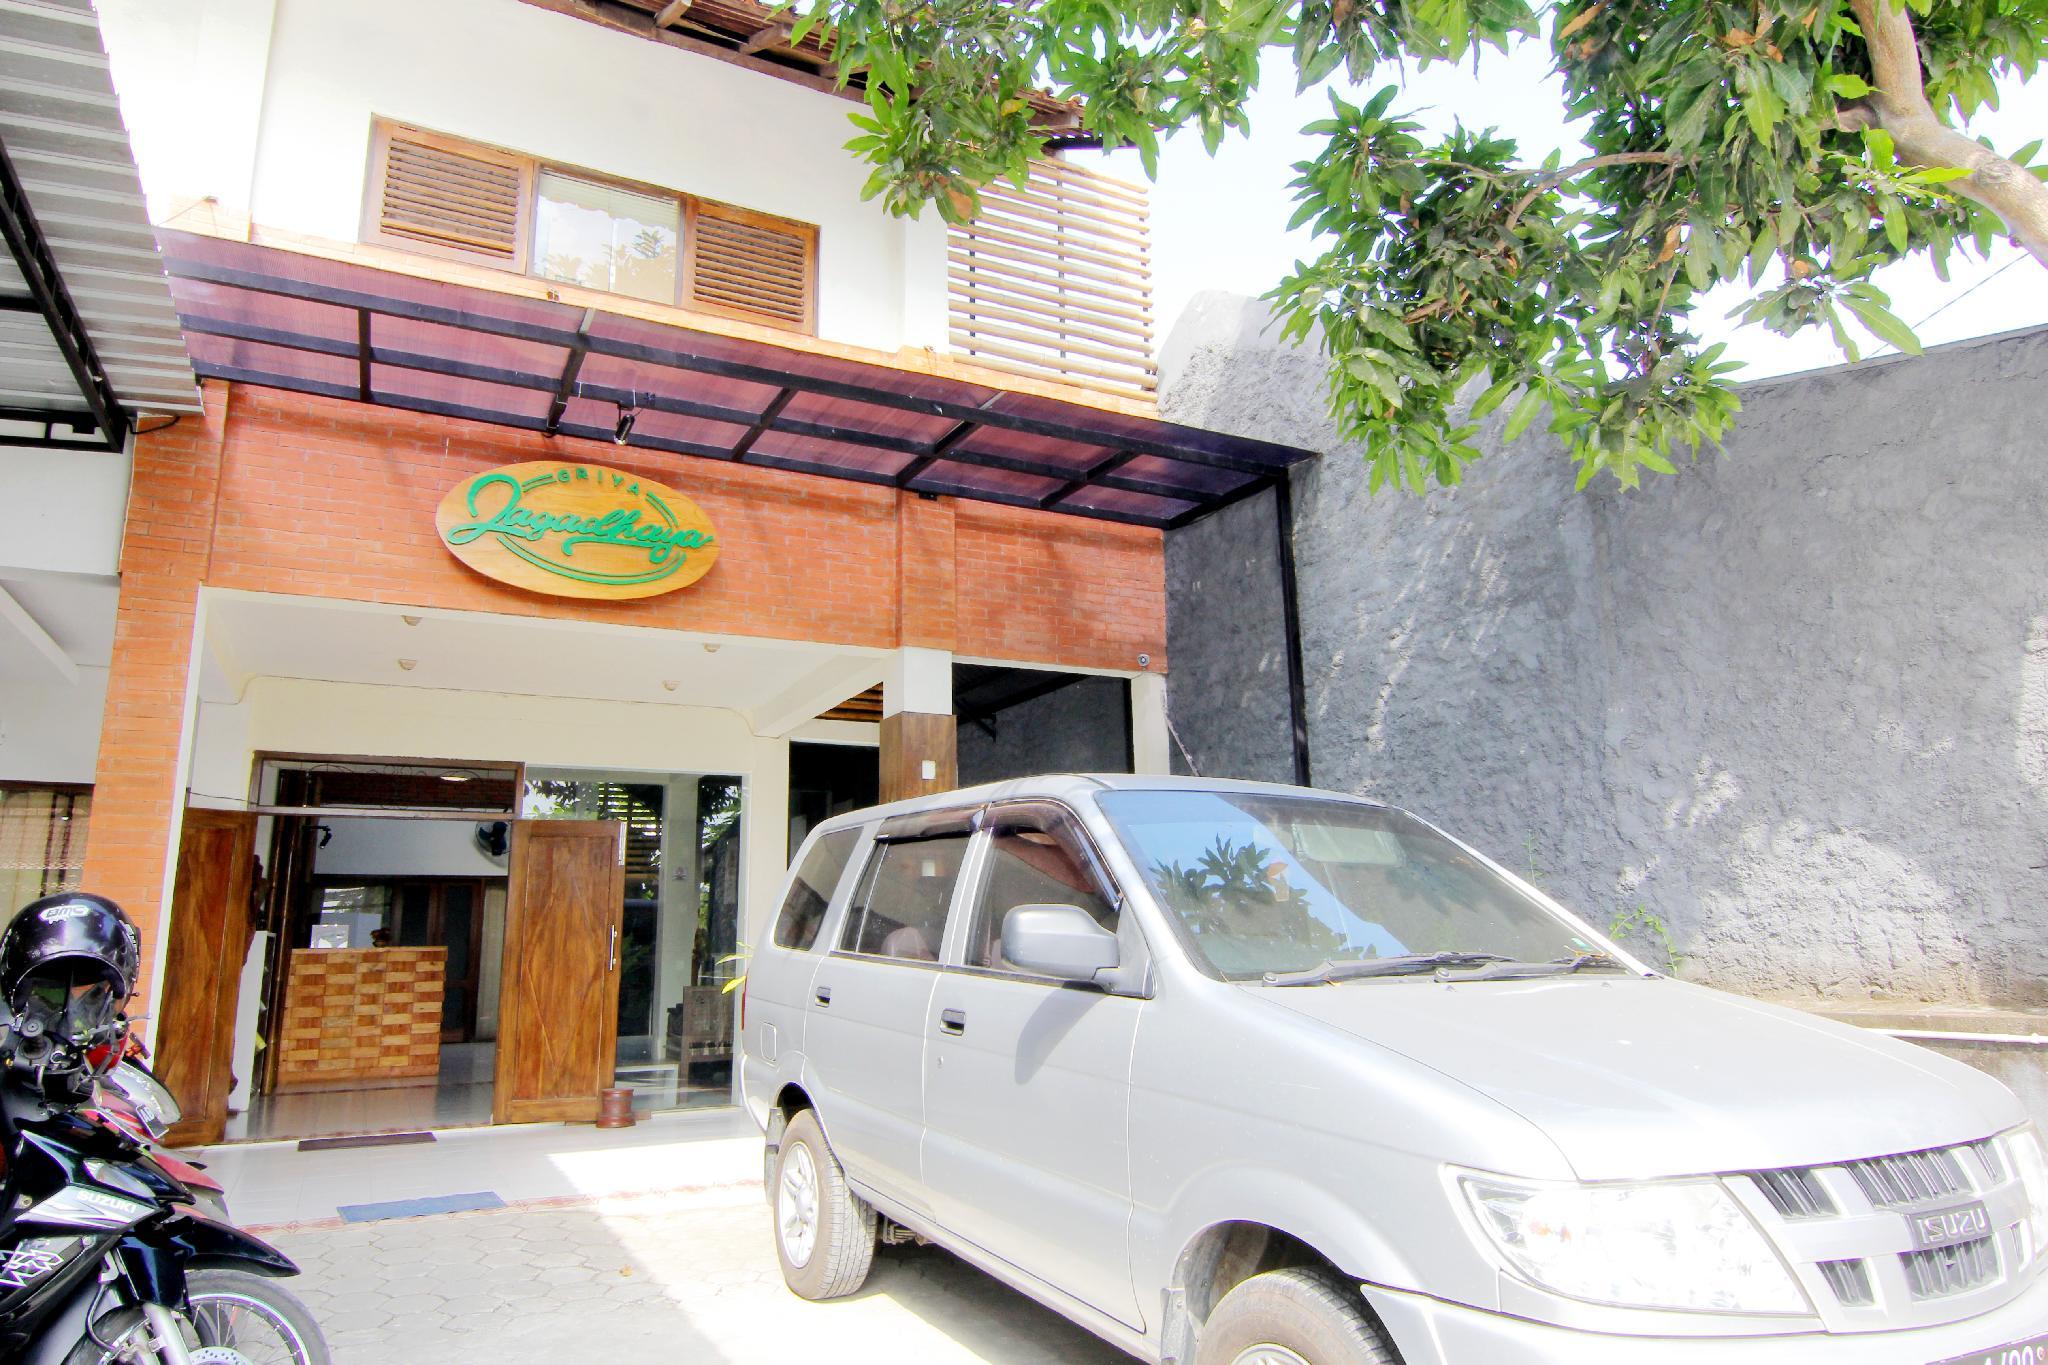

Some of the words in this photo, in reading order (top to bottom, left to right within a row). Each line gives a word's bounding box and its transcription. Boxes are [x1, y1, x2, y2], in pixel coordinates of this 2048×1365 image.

[557, 467, 640, 496] GRIYA
[76, 1190, 137, 1214] SUZUKI
[1916, 1208, 1986, 1244] ISUZU
